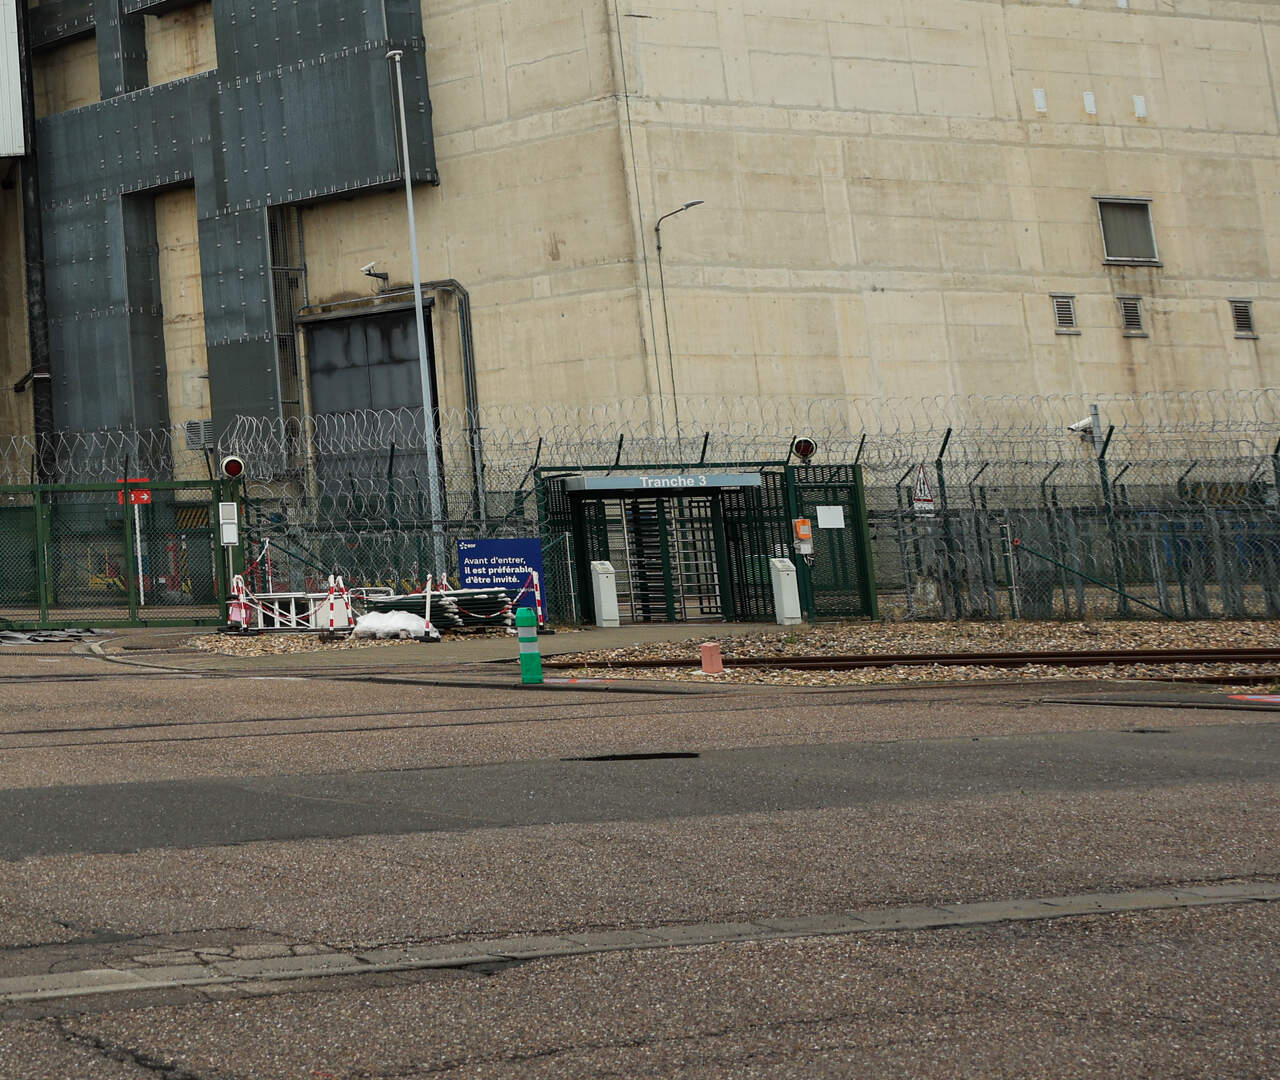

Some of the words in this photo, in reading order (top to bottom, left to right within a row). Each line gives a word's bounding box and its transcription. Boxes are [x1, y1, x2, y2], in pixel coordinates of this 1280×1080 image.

[640, 475, 695, 488] Tranche
[698, 475, 706, 486] 3
[464, 557, 488, 565] Avant
[490, 556, 526, 565] d'entrer,
[464, 566, 471, 574] il
[488, 565, 533, 576] préférable
[465, 576, 491, 584] d'être
[493, 575, 520, 583] invité.
